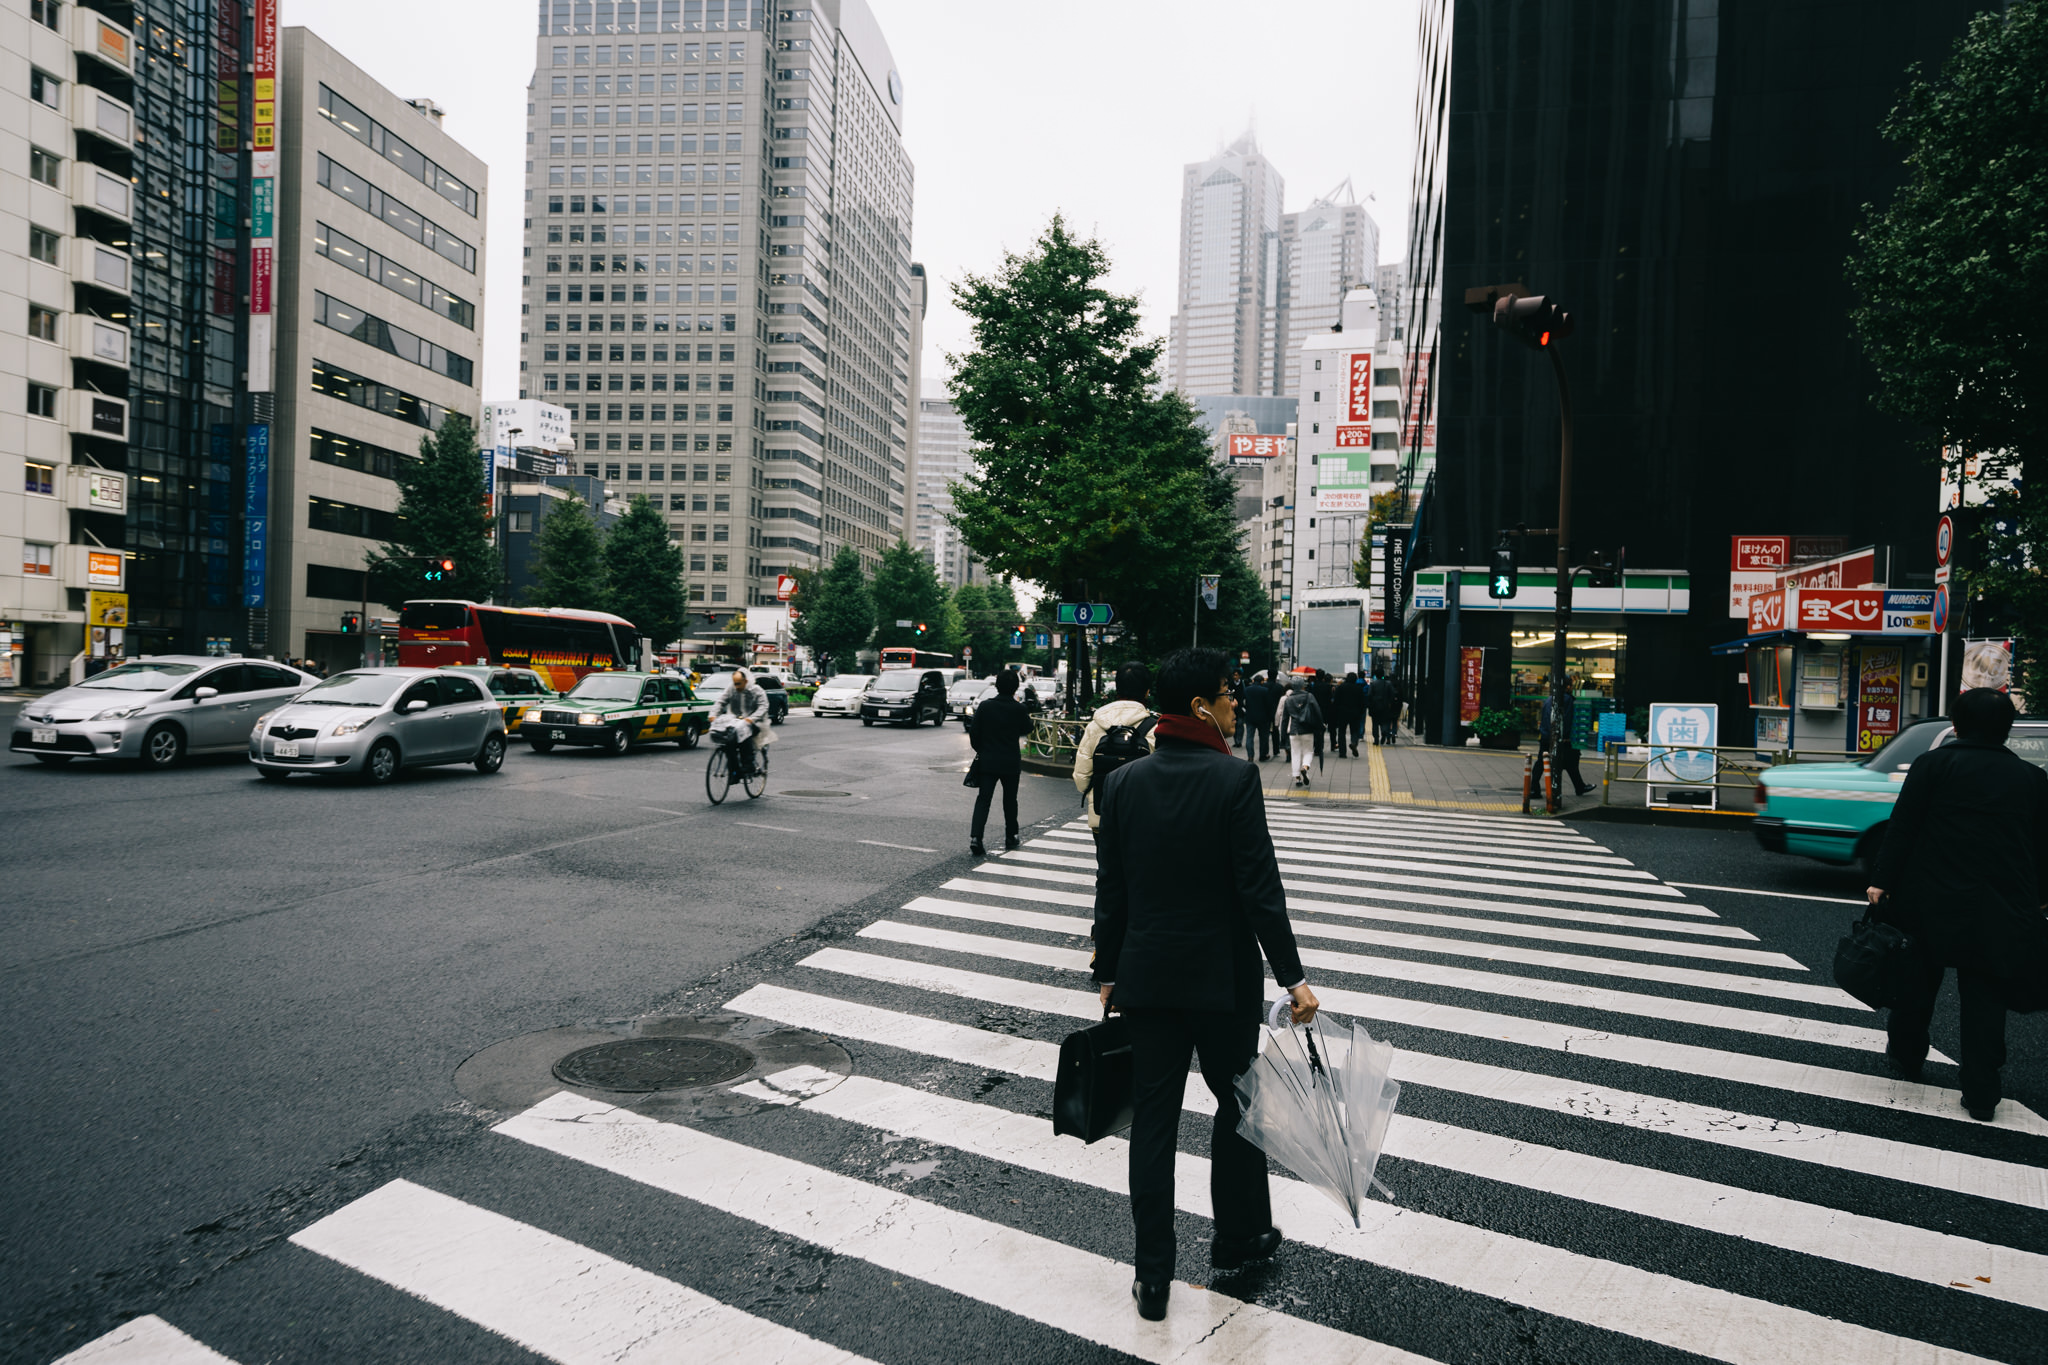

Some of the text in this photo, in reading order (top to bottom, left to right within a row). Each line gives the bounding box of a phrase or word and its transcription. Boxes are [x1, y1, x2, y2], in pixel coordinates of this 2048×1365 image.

[1352, 360, 1368, 415] クリナップ
[1234, 436, 1286, 456] やまや
[1741, 545, 1781, 554] ほけんの
[1940, 530, 1948, 551] 40
[252, 520, 264, 605] グローリア
[1393, 557, 1402, 576] SUIT
[1750, 556, 1769, 565] 窓口
[1733, 583, 1774, 592] 無料相談
[1393, 578, 1402, 619] COMPANY
[1888, 594, 1932, 605] NUMBERS
[1079, 608, 1087, 620] 8
[1752, 595, 1781, 630] 宝くじ
[1802, 598, 1879, 621] 宝くじ
[1887, 615, 1912, 628] LOTO
[503, 648, 613, 666] OSAKA KOMBINAT BUS
[1867, 706, 1891, 722] 1等
[1667, 717, 1699, 744] 歯
